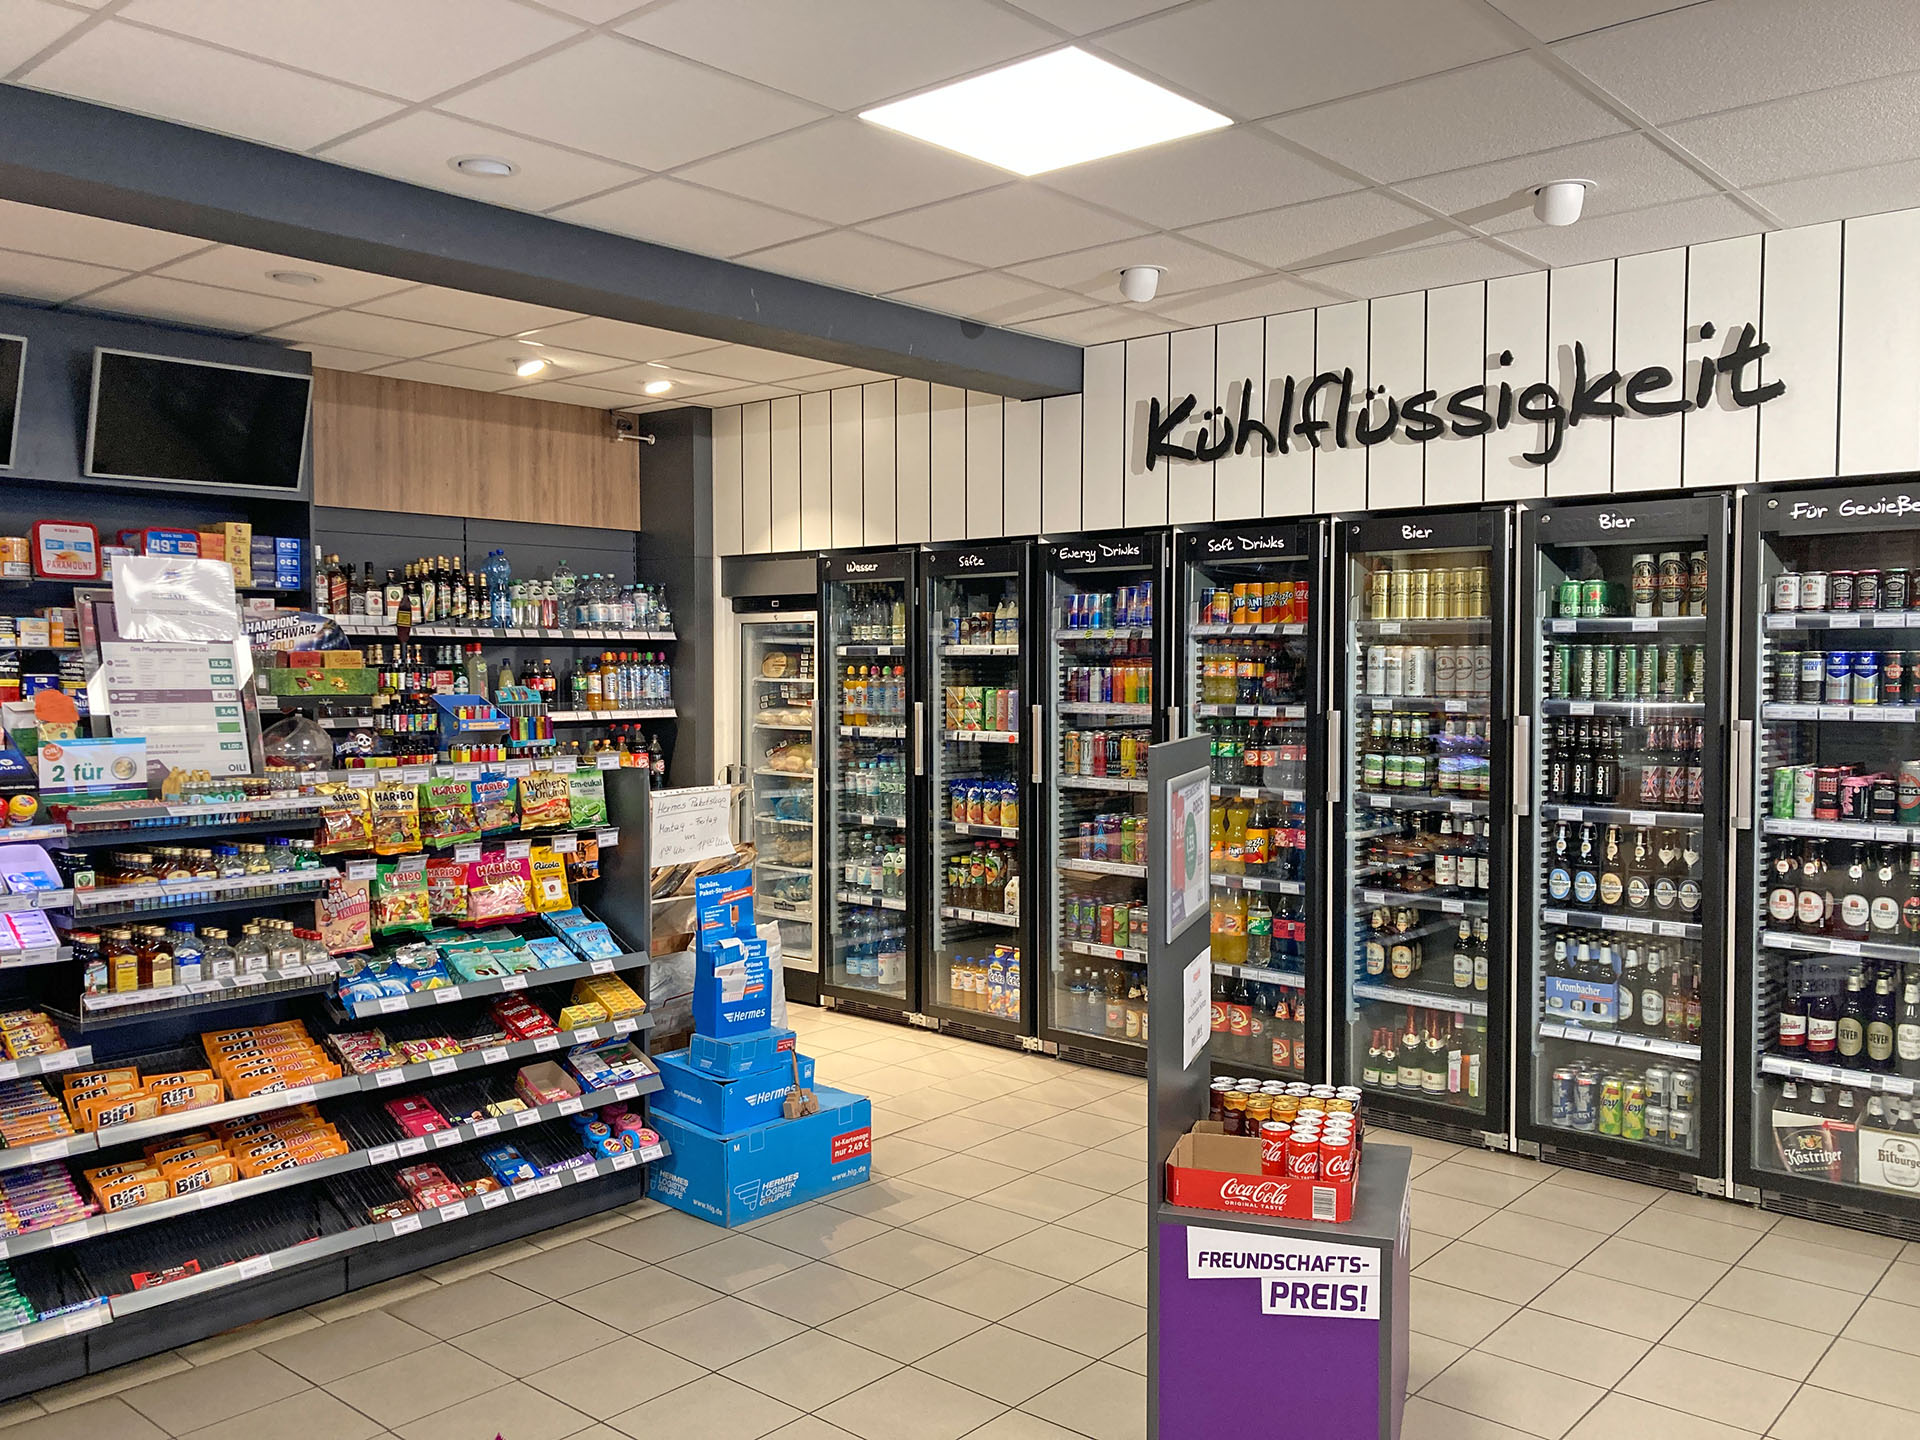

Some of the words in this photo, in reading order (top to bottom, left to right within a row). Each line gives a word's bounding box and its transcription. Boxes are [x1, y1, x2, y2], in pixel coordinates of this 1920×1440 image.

[1147, 321, 1786, 471] Kühlflüssigkeit
[1789, 502, 1828, 519] Für
[1599, 513, 1635, 529] Bier
[1401, 525, 1433, 540] Bier
[279, 541, 298, 549] OCB
[1207, 537, 1234, 552] Soft
[1237, 535, 1285, 550] Drinks
[958, 555, 985, 567] Säfte
[1059, 548, 1097, 563] Energy
[1099, 543, 1140, 557] Drinks
[46, 560, 93, 571] PARAMOUNT
[279, 558, 298, 566] OCB
[846, 562, 878, 573] Wasser
[1633, 576, 1658, 586] FAXE
[1659, 576, 1688, 586] FAXE
[247, 615, 300, 633] HAMPIONS
[256, 632, 268, 644] IN
[269, 624, 317, 641] SCHWARZ
[270, 639, 295, 650] GOLD
[1408, 654, 1416, 685] Krombacher
[52, 765, 65, 782] 2
[73, 763, 104, 780] für
[228, 763, 247, 772] OIL!
[476, 780, 510, 793] HARIBO
[523, 777, 567, 791] Werther's
[570, 779, 602, 788] Em-eukal
[1574, 764, 1582, 793] bibop
[374, 791, 414, 802] HARIBO
[432, 783, 467, 796] HARIBO
[535, 784, 567, 799] Original
[657, 801, 687, 815] Hermes
[659, 822, 685, 832] Montag
[428, 867, 461, 877] HARIBO
[477, 860, 521, 877] HARIBO
[534, 861, 560, 870] Ricola
[385, 871, 422, 883] HARIBO
[1555, 980, 1601, 996] Krombacher
[516, 1014, 543, 1029] Skittles
[734, 1007, 766, 1023] Hermes
[260, 1034, 283, 1046] Roll
[72, 1073, 107, 1088] BiFi
[73, 1086, 108, 1109] BiFi
[162, 1086, 194, 1107] BiFi
[757, 1084, 796, 1106] Hermes
[99, 1102, 136, 1127] BiFi
[250, 1138, 287, 1158] BiFi
[288, 1131, 312, 1147] Roll
[834, 1132, 869, 1147] M-Kartonage
[733, 1144, 740, 1152] M
[834, 1149, 847, 1158] nur
[847, 1143, 862, 1155] 2,49
[863, 1140, 870, 1149] €
[300, 1151, 324, 1166] Roll
[1784, 1148, 1842, 1167] Köstritzer
[550, 1158, 584, 1175] Milka
[831, 1165, 867, 1182] www.hlg.de
[176, 1168, 211, 1194] BiFi
[658, 1177, 687, 1193] LOGISTIK
[659, 1170, 689, 1186] HERMES
[761, 1172, 799, 1190] HERMES
[110, 1184, 146, 1209] BiFi
[657, 1184, 684, 1200] GRUPPE
[759, 1189, 792, 1207] GRUPPE
[760, 1181, 796, 1199] LOGISTIK
[1220, 1178, 1293, 1206] Coca-Cola
[692, 1199, 723, 1216] www.hlg.de
[1224, 1200, 1258, 1209] ORIGINAL
[1260, 1203, 1284, 1211] TASTE
[1198, 1251, 1370, 1274] FREUNDSCHAFTS-
[1269, 1281, 1369, 1312] PREIS!
